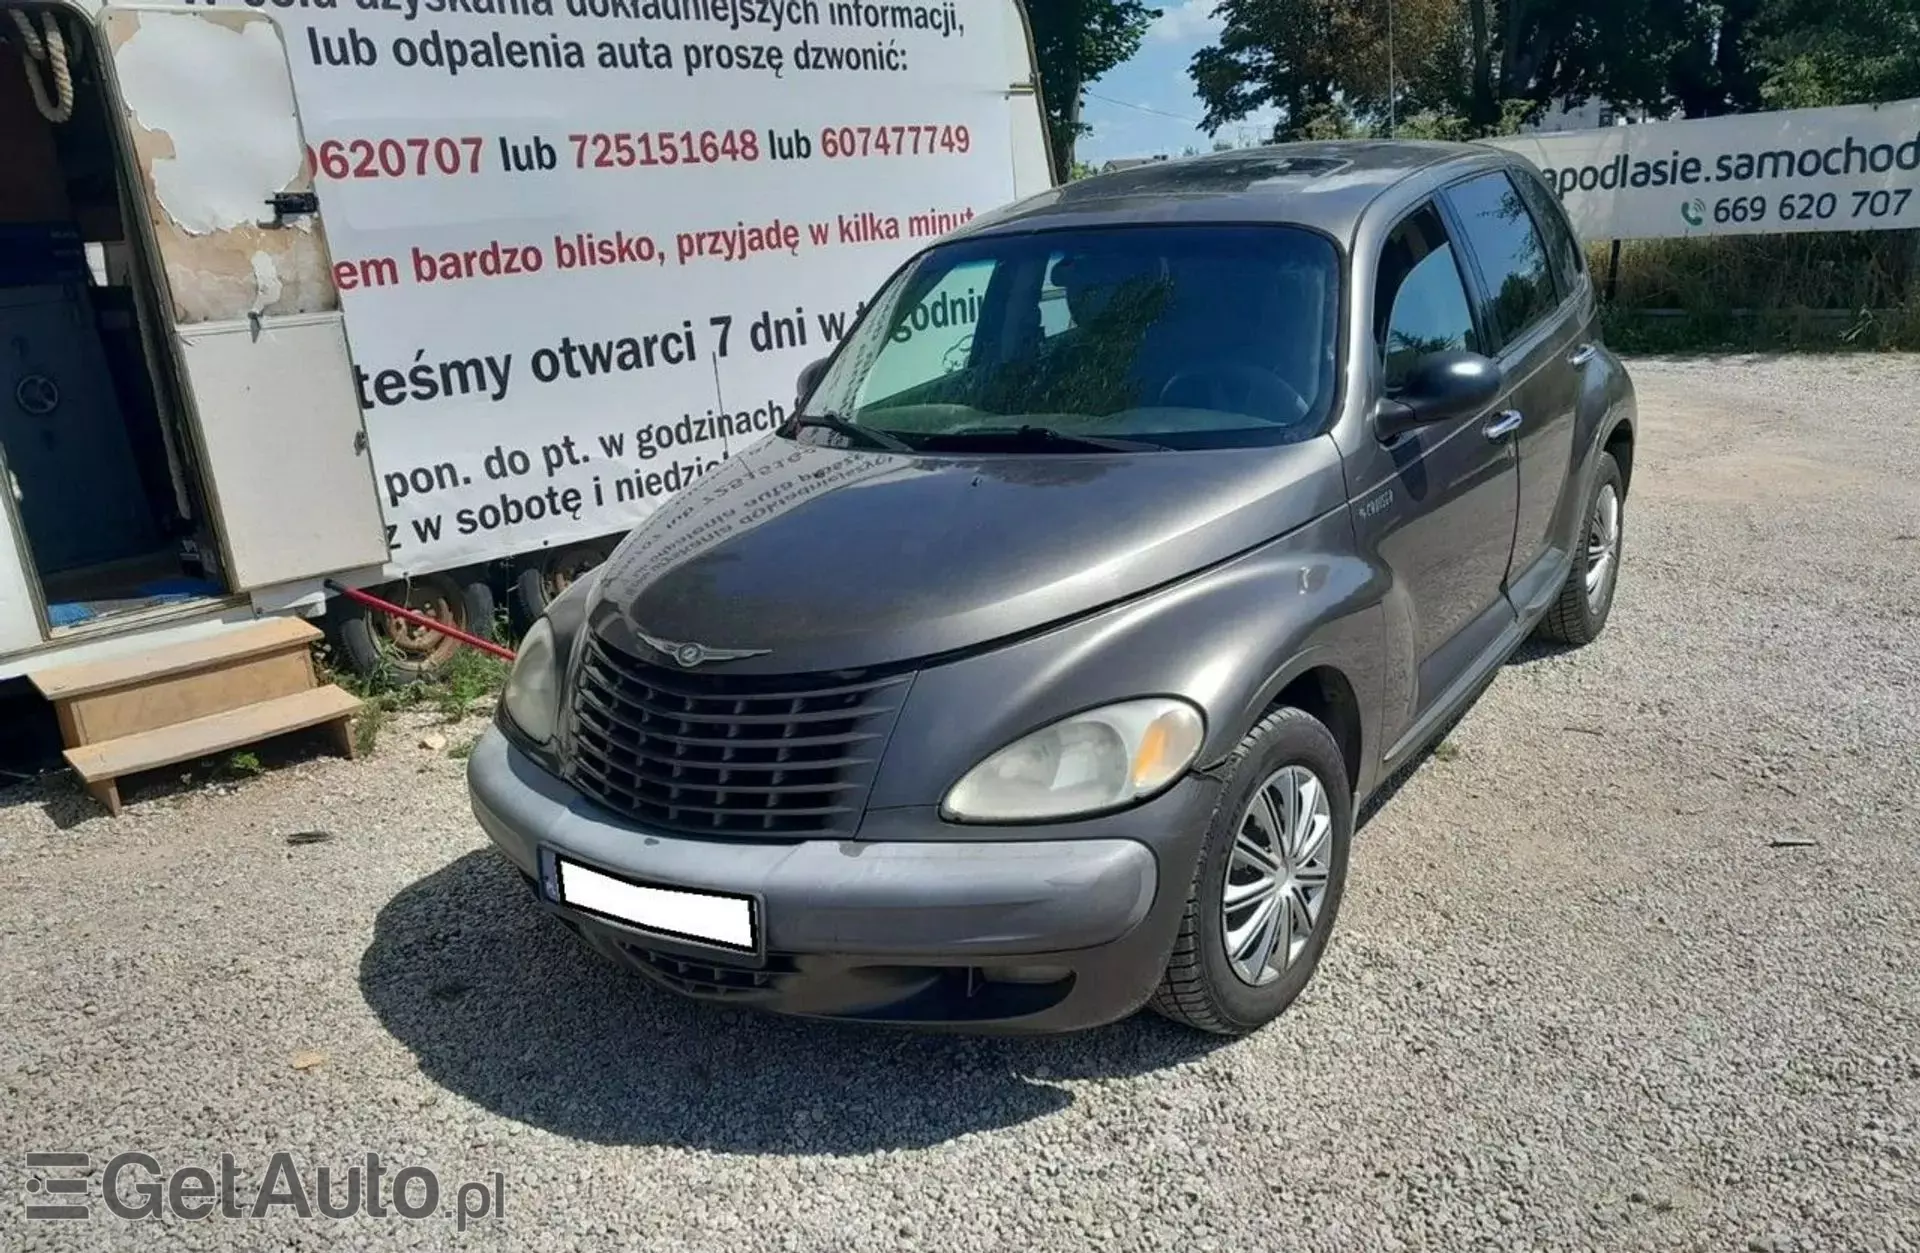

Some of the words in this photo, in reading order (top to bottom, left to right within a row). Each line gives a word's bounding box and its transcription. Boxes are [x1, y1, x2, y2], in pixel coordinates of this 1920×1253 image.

[830, 0, 964, 37] informacji,
[307, 27, 377, 66] lub
[392, 30, 585, 75] odpalenia
[596, 37, 673, 69] auta
[683, 43, 783, 78] proszę
[794, 39, 907, 71] dzwonić:
[499, 136, 557, 172] lub
[569, 129, 759, 168] 725151648
[769, 129, 811, 160] lub
[821, 125, 970, 158] 607477749
[1714, 197, 1766, 223] 669
[1779, 192, 1837, 220] 620
[1851, 188, 1912, 217] 707
[411, 240, 542, 283] bardzo
[555, 231, 665, 269] blisko,
[677, 219, 799, 262] przyjadę
[808, 222, 829, 246] w
[839, 211, 899, 243] kilka
[531, 321, 696, 378] otwarci
[710, 315, 732, 357] 7
[750, 307, 807, 352] dni
[818, 311, 846, 342] w
[384, 461, 471, 507] pon.
[484, 445, 530, 480] do
[541, 435, 589, 477] pt.
[600, 432, 624, 459] w
[636, 400, 784, 459] godzinach
[412, 515, 441, 544] w
[456, 487, 582, 534] sobotę
[594, 477, 604, 506] i
